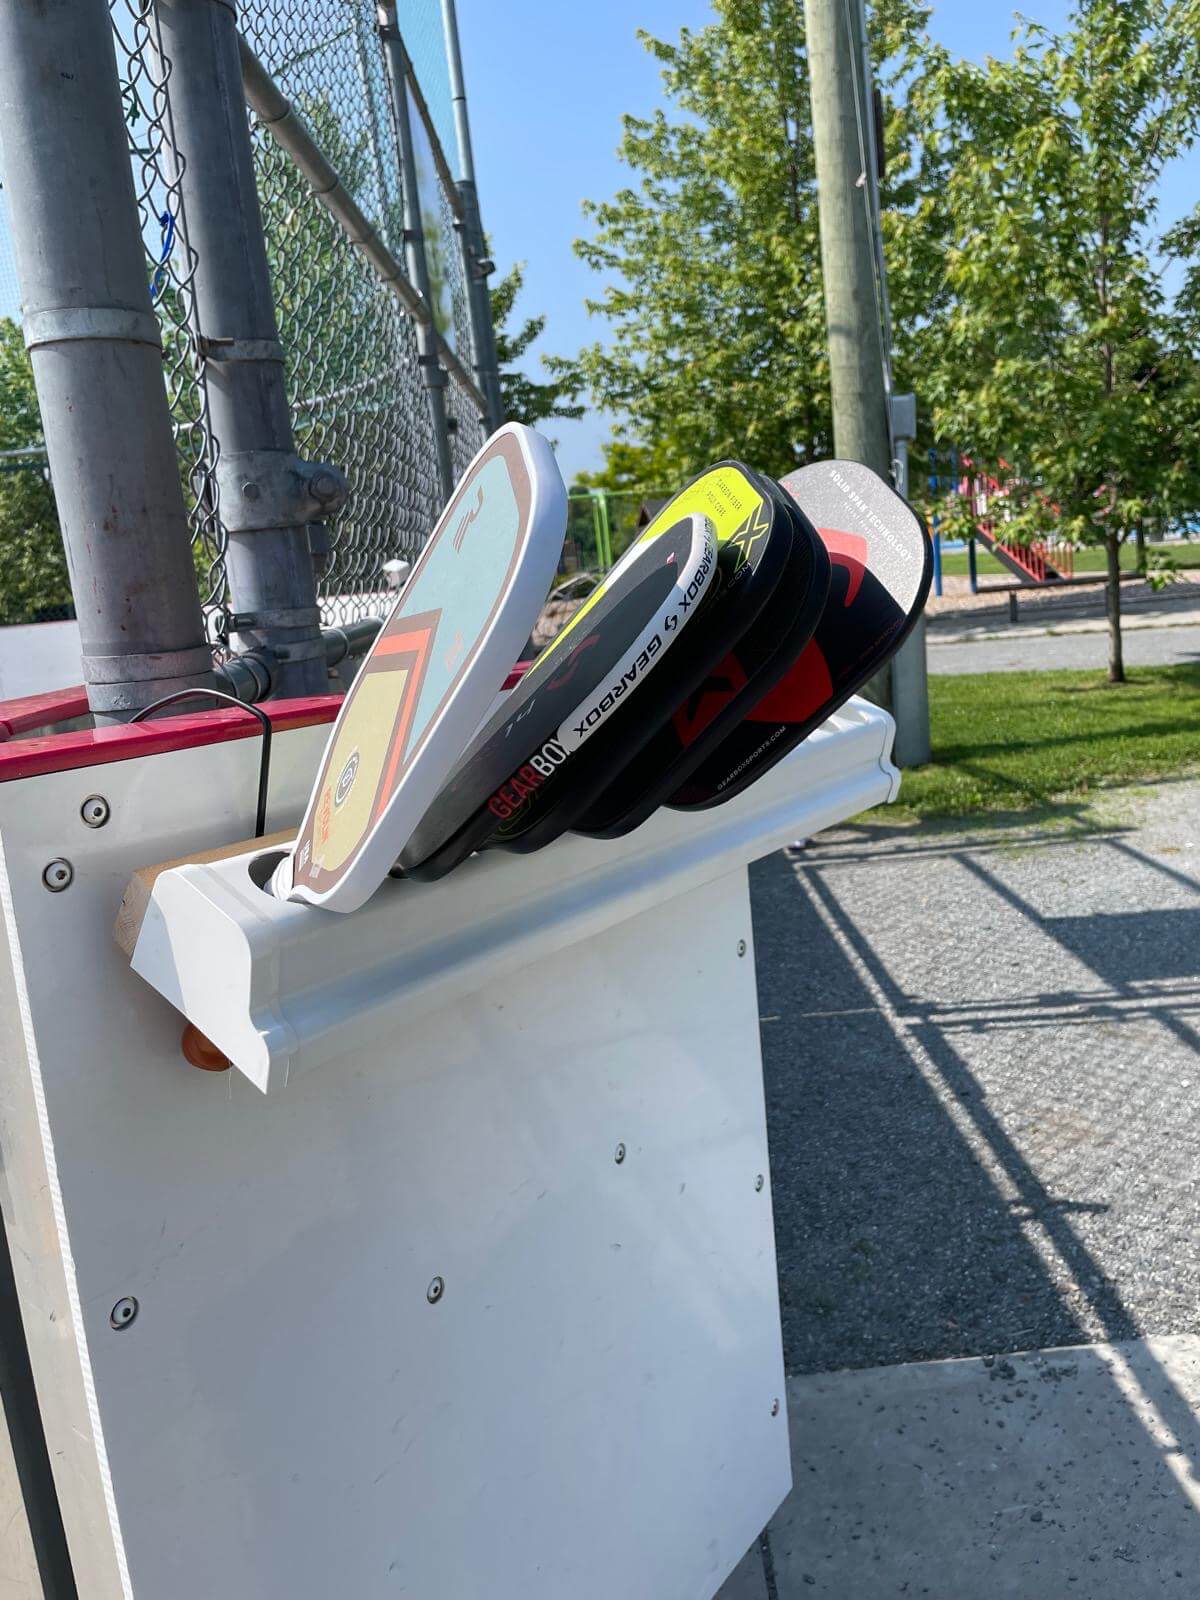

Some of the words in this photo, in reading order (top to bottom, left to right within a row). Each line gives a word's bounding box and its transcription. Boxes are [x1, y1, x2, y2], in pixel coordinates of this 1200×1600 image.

[829, 470, 850, 493] SOLID
[848, 491, 869, 513] SPAN
[866, 510, 913, 562] TECHNOLOGY
[572, 633, 663, 738] GEARBOX
